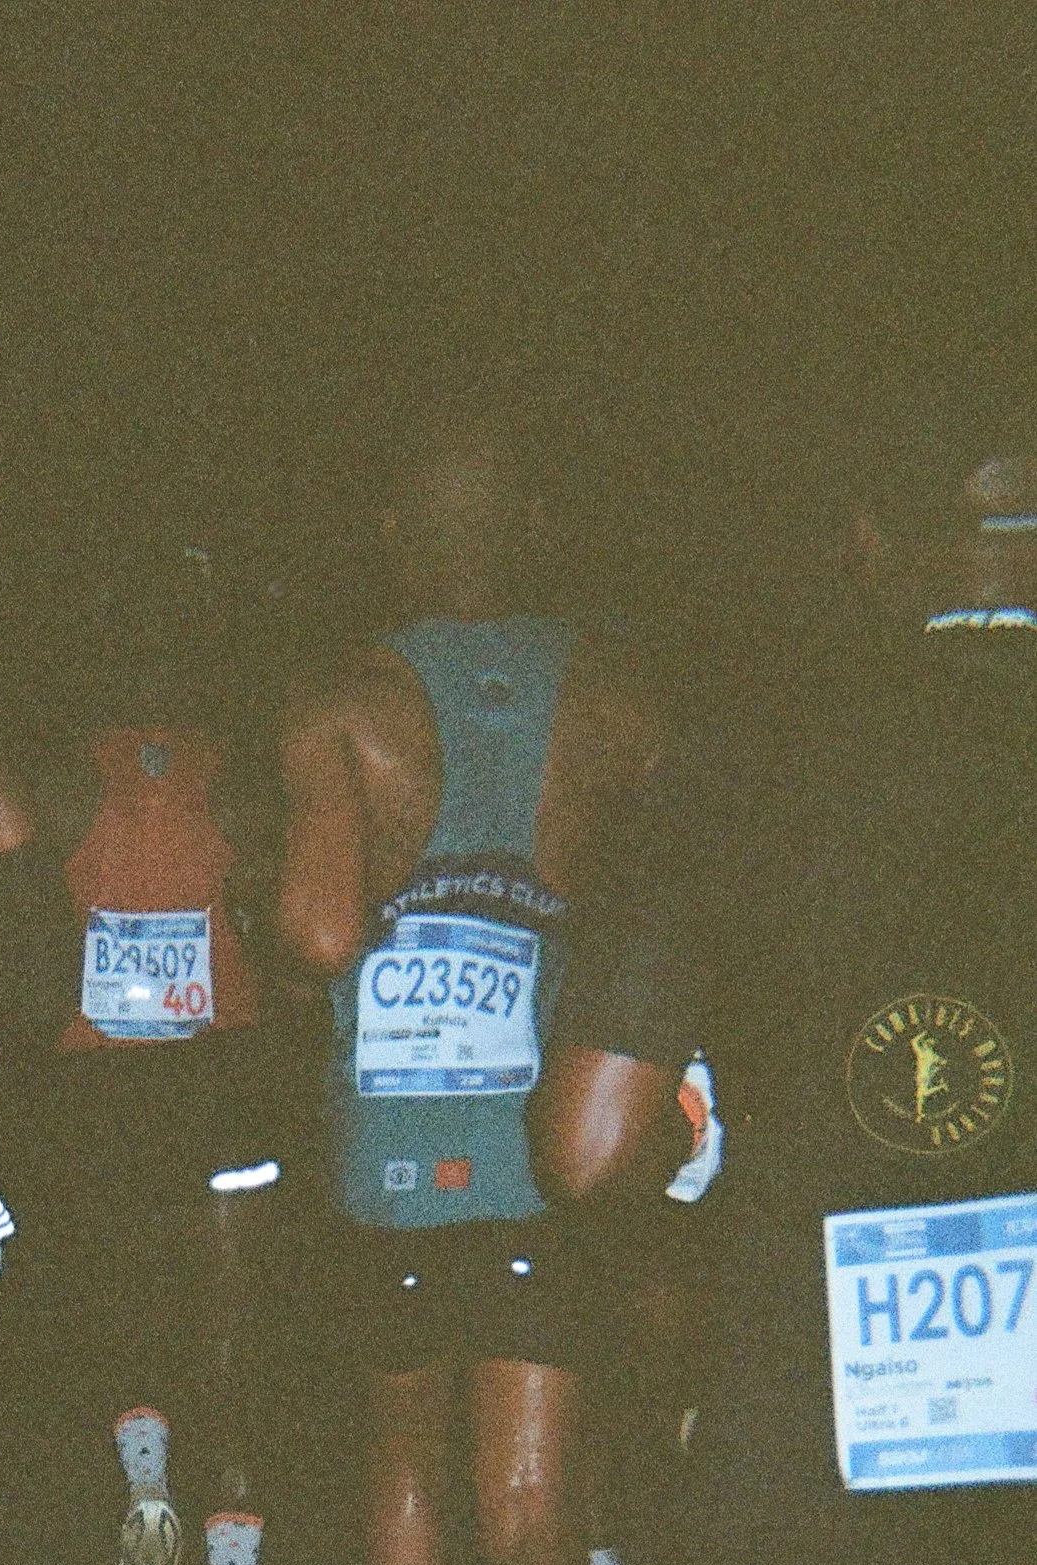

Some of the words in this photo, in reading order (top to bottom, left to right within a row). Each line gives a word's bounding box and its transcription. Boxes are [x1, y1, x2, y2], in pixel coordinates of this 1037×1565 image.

[95, 937, 197, 980] B29509
[162, 981, 208, 1018] 40
[371, 957, 521, 1019] C23529
[856, 1259, 1034, 1347] H207
[844, 1357, 919, 1381] Ngaiso
